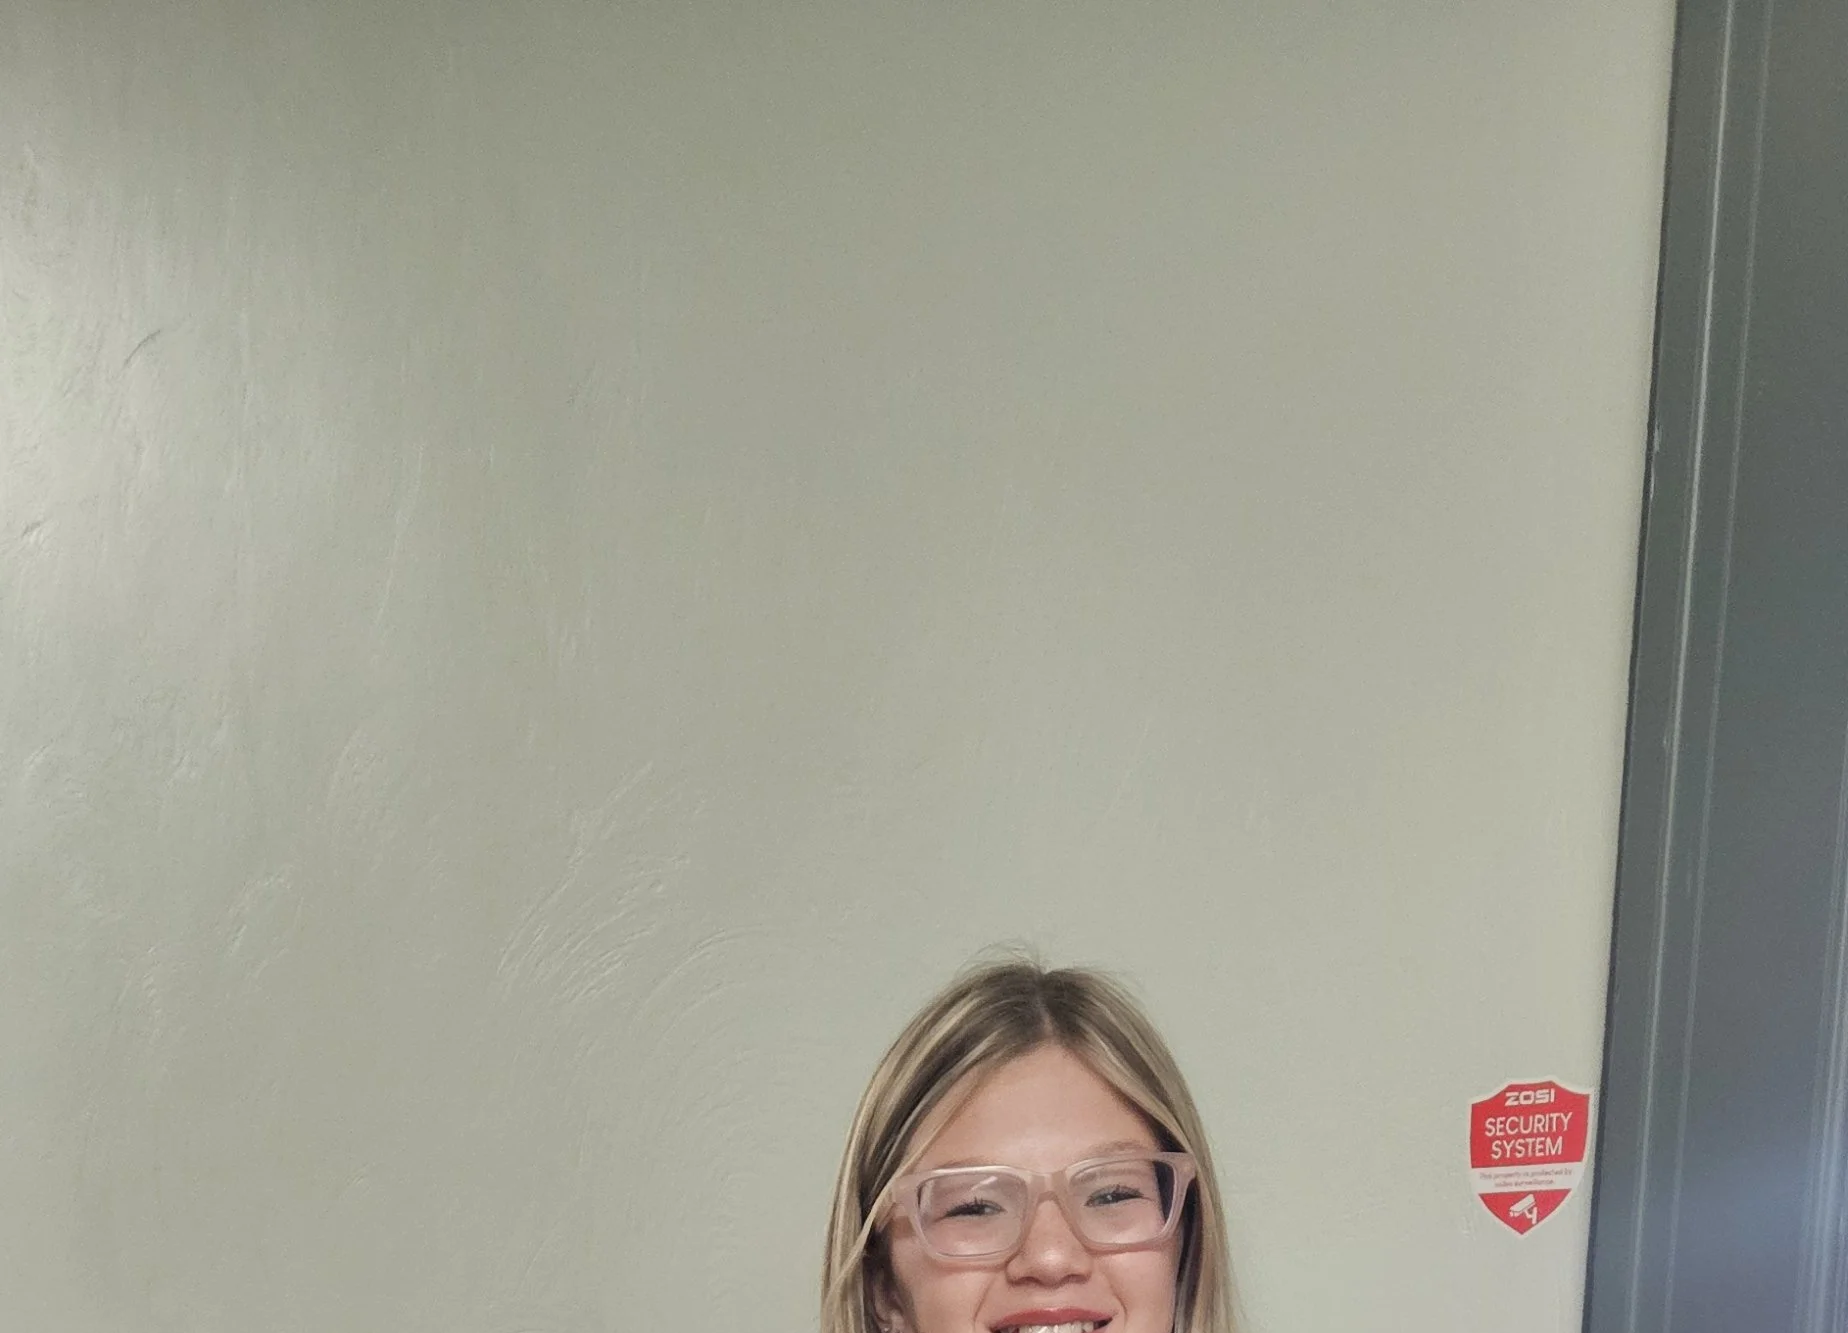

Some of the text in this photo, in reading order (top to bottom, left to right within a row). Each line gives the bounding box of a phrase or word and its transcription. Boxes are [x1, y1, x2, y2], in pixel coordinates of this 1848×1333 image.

[1504, 1088, 1555, 1107] ZOSI
[1485, 1112, 1573, 1137] SECURITY
[1491, 1136, 1563, 1160] SYSTEM
